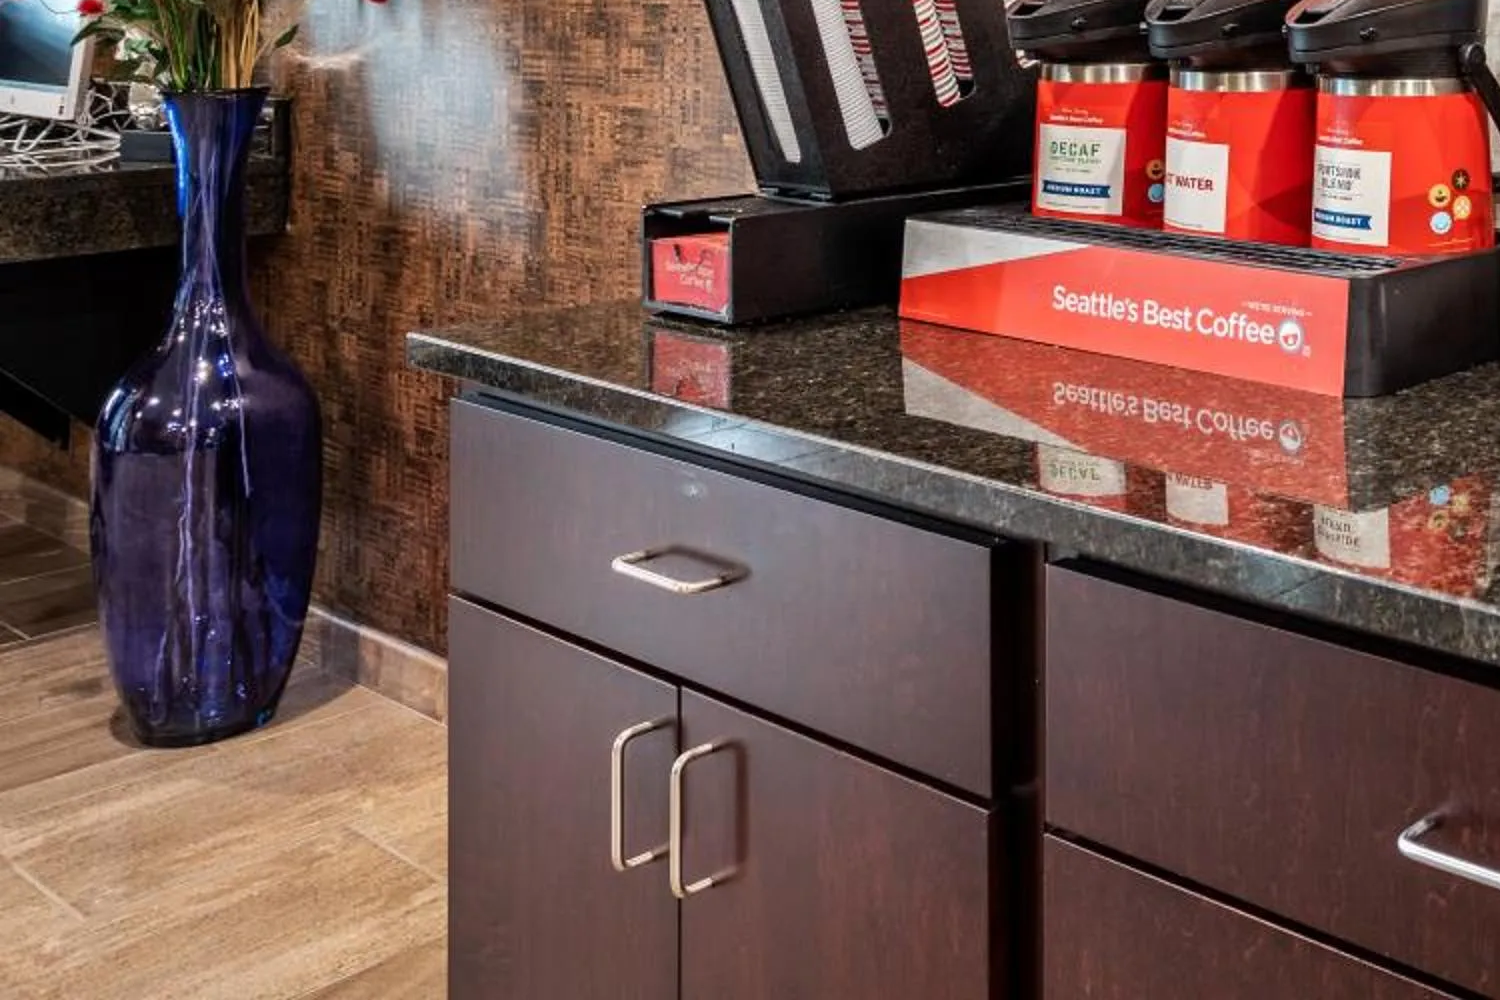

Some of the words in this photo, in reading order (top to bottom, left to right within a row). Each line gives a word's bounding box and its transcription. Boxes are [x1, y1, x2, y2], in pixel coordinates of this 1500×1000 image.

[1050, 141, 1101, 157] DECAF
[1175, 175, 1214, 191] WATER
[1052, 285, 1138, 323] Seattle's
[1143, 299, 1192, 332] Best
[1197, 308, 1276, 345] Coffee
